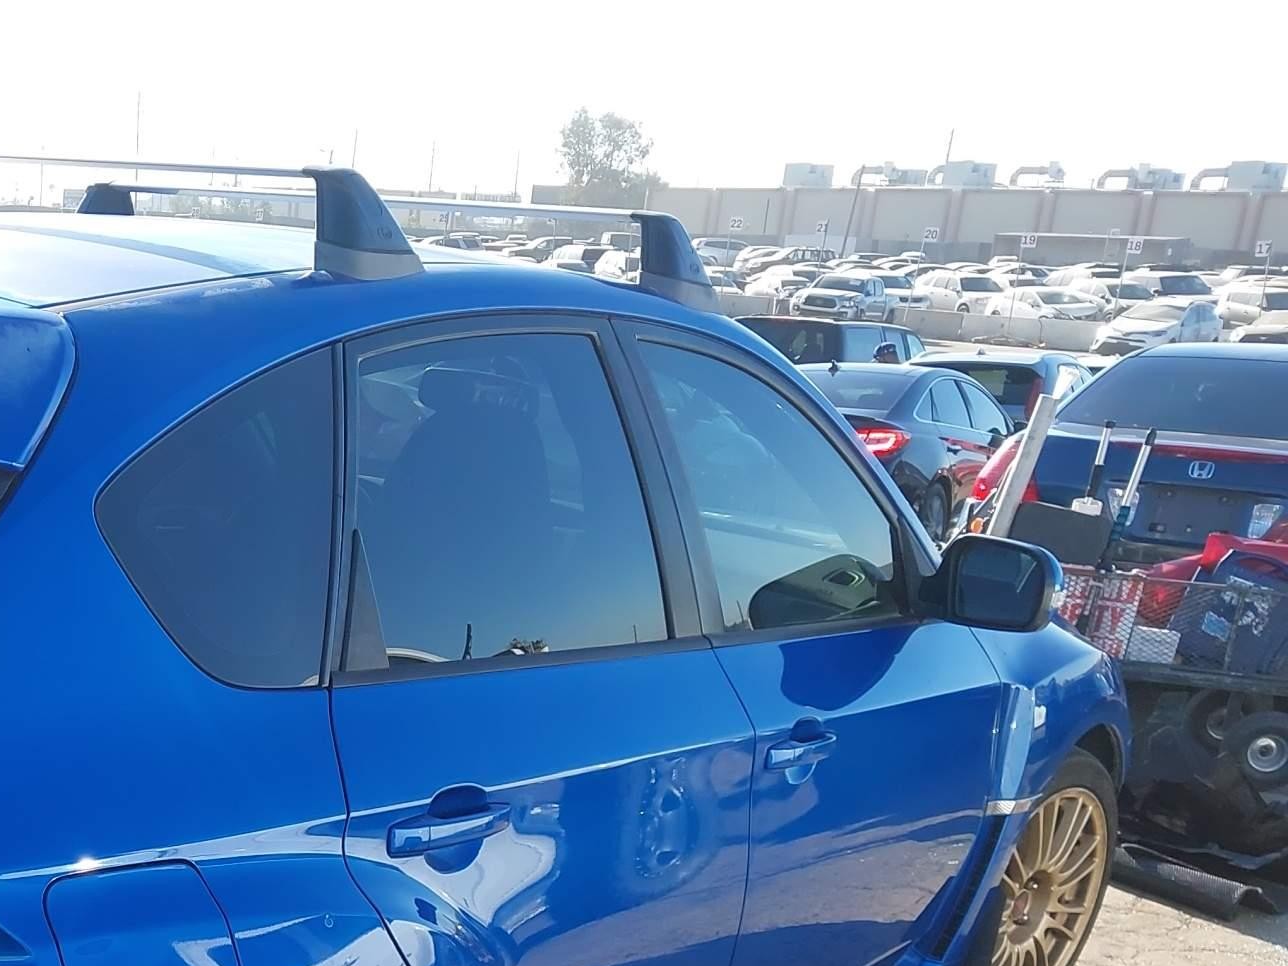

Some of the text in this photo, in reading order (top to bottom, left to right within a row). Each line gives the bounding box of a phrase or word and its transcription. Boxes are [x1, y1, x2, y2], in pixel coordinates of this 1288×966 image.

[730, 219, 743, 228] 22
[816, 223, 828, 232] 21
[924, 229, 938, 240] 20
[1022, 234, 1036, 245] 19
[1128, 240, 1142, 251] 18
[1257, 242, 1272, 254] 17
